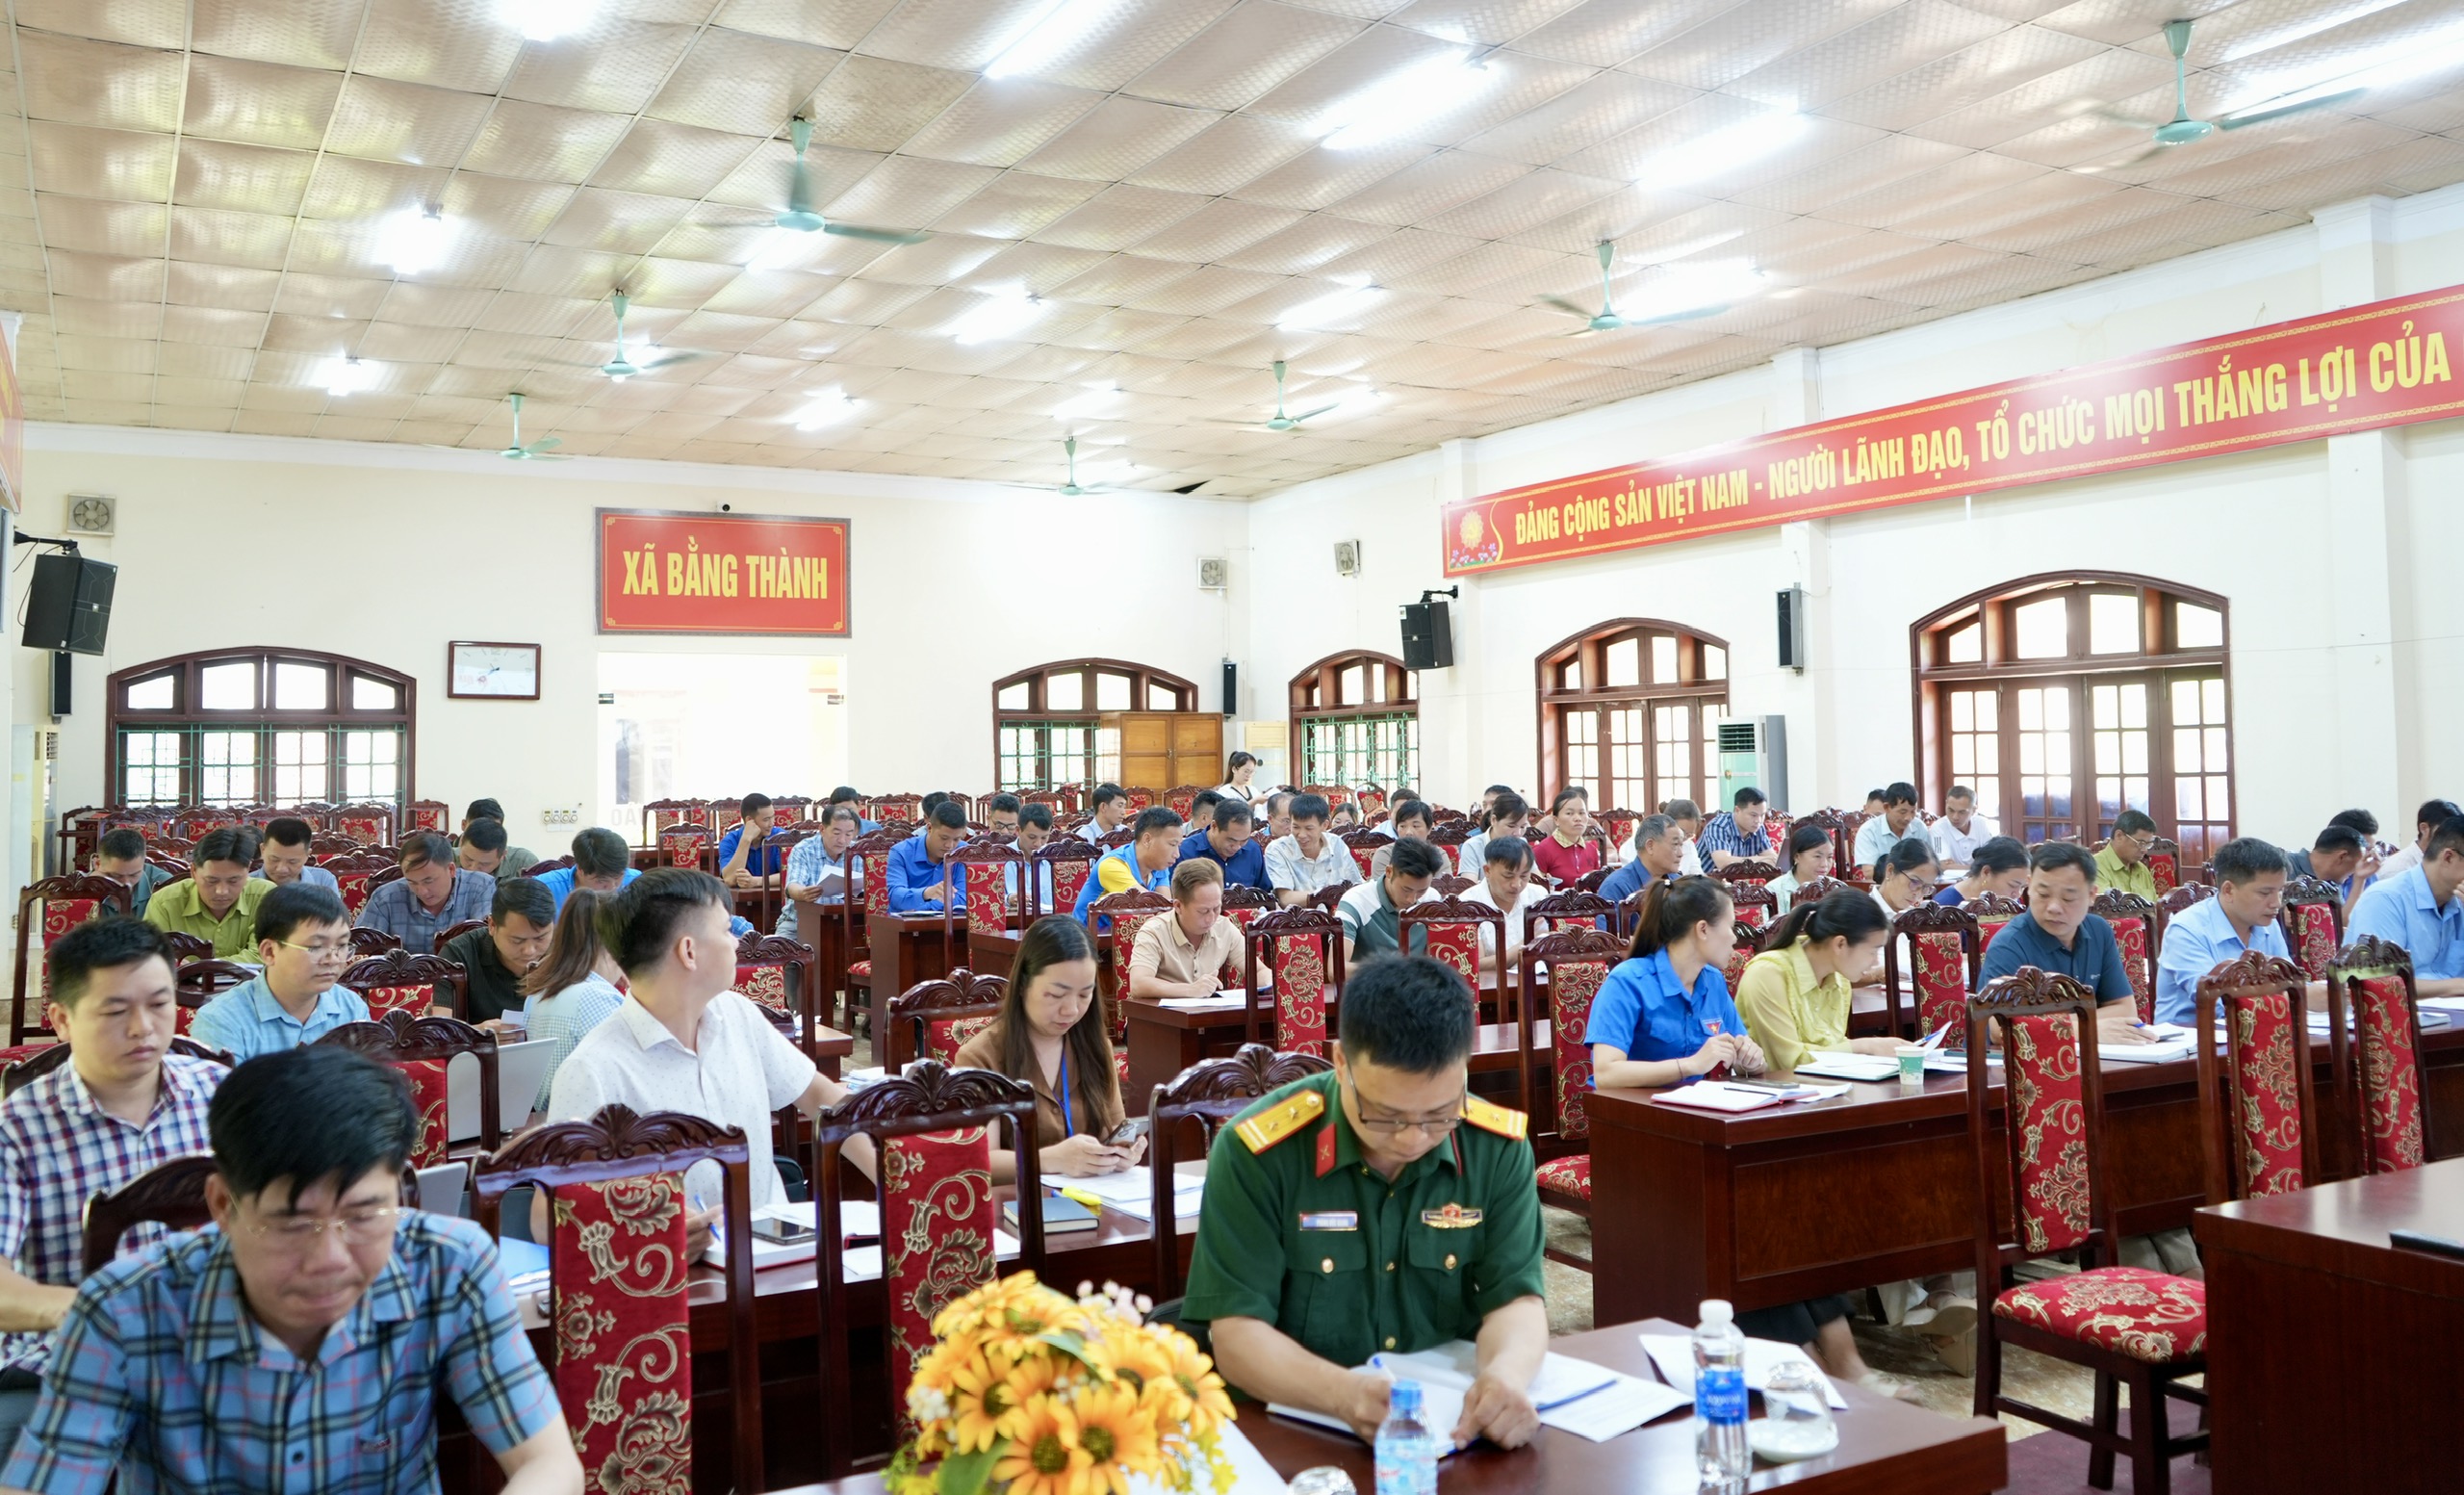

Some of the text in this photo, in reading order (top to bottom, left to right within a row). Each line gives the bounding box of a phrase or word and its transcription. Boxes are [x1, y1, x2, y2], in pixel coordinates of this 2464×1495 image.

[1515, 500, 1559, 545] ĐẢNG
[1563, 494, 1610, 542] CỘNG
[1614, 479, 1652, 527] SẢN
[1656, 474, 1696, 524] VIỆT
[1701, 469, 1748, 512] NAM
[1768, 443, 1836, 500] NGƯỜI
[1842, 436, 1905, 486] LÃNH
[1911, 425, 1969, 479] ĐẠO,
[1976, 399, 2010, 462] TỔ
[2018, 395, 2095, 455] CHỨC
[2105, 386, 2165, 445] MỌI
[2173, 354, 2288, 427] THẮNG
[2298, 346, 2356, 413] LỢI
[2369, 320, 2452, 393] CỦA
[622, 535, 828, 600] XÃ BẰNG THÀNH
